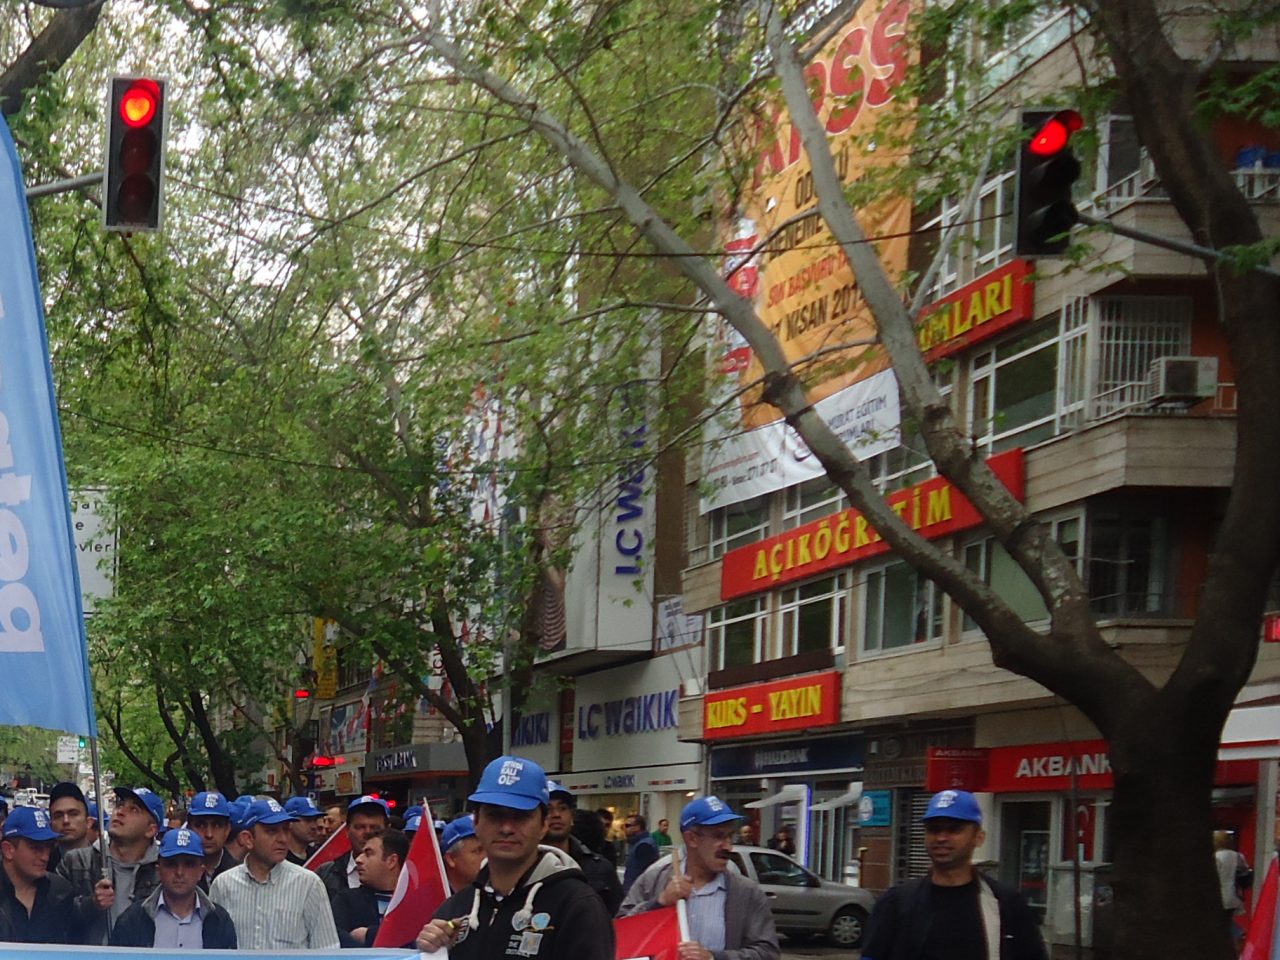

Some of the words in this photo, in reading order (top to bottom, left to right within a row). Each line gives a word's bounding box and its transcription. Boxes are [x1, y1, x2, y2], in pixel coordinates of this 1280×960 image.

[752, 485, 953, 581] AÇIKÖĞRTİM
[706, 697, 747, 729] KURS
[769, 684, 823, 721] YAYIN
[1015, 753, 1113, 778] AKBANK
